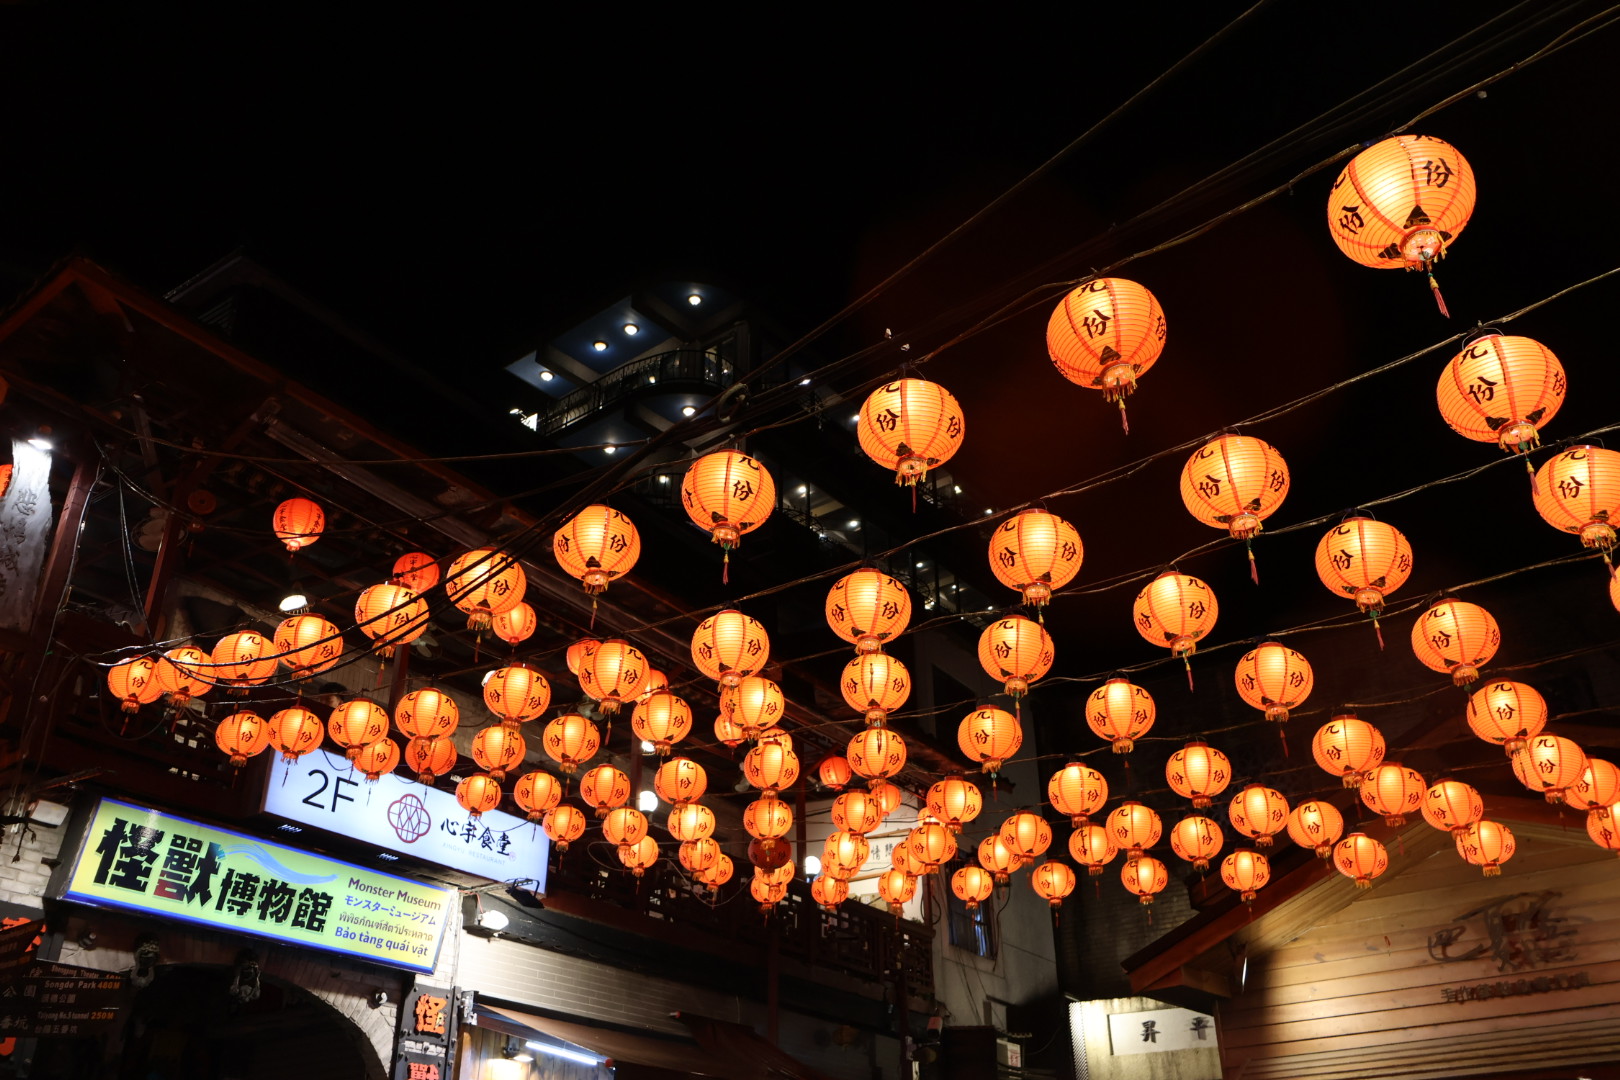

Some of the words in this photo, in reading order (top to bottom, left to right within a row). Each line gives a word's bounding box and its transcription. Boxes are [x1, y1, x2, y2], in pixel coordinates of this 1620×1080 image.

[302, 769, 359, 812] 2F
[440, 818, 511, 856] 心宇食堂
[93, 817, 334, 934] 怪獸博物館
[344, 895, 436, 926] モンスターミュージアム
[347, 877, 395, 898] Monster
[396, 890, 441, 911] Museum
[335, 926, 356, 940] Bảo
[358, 931, 384, 949] tàng
[385, 939, 410, 953] quái
[411, 944, 429, 958] vật
[44, 980, 75, 990] Songde
[77, 980, 97, 990] Park
